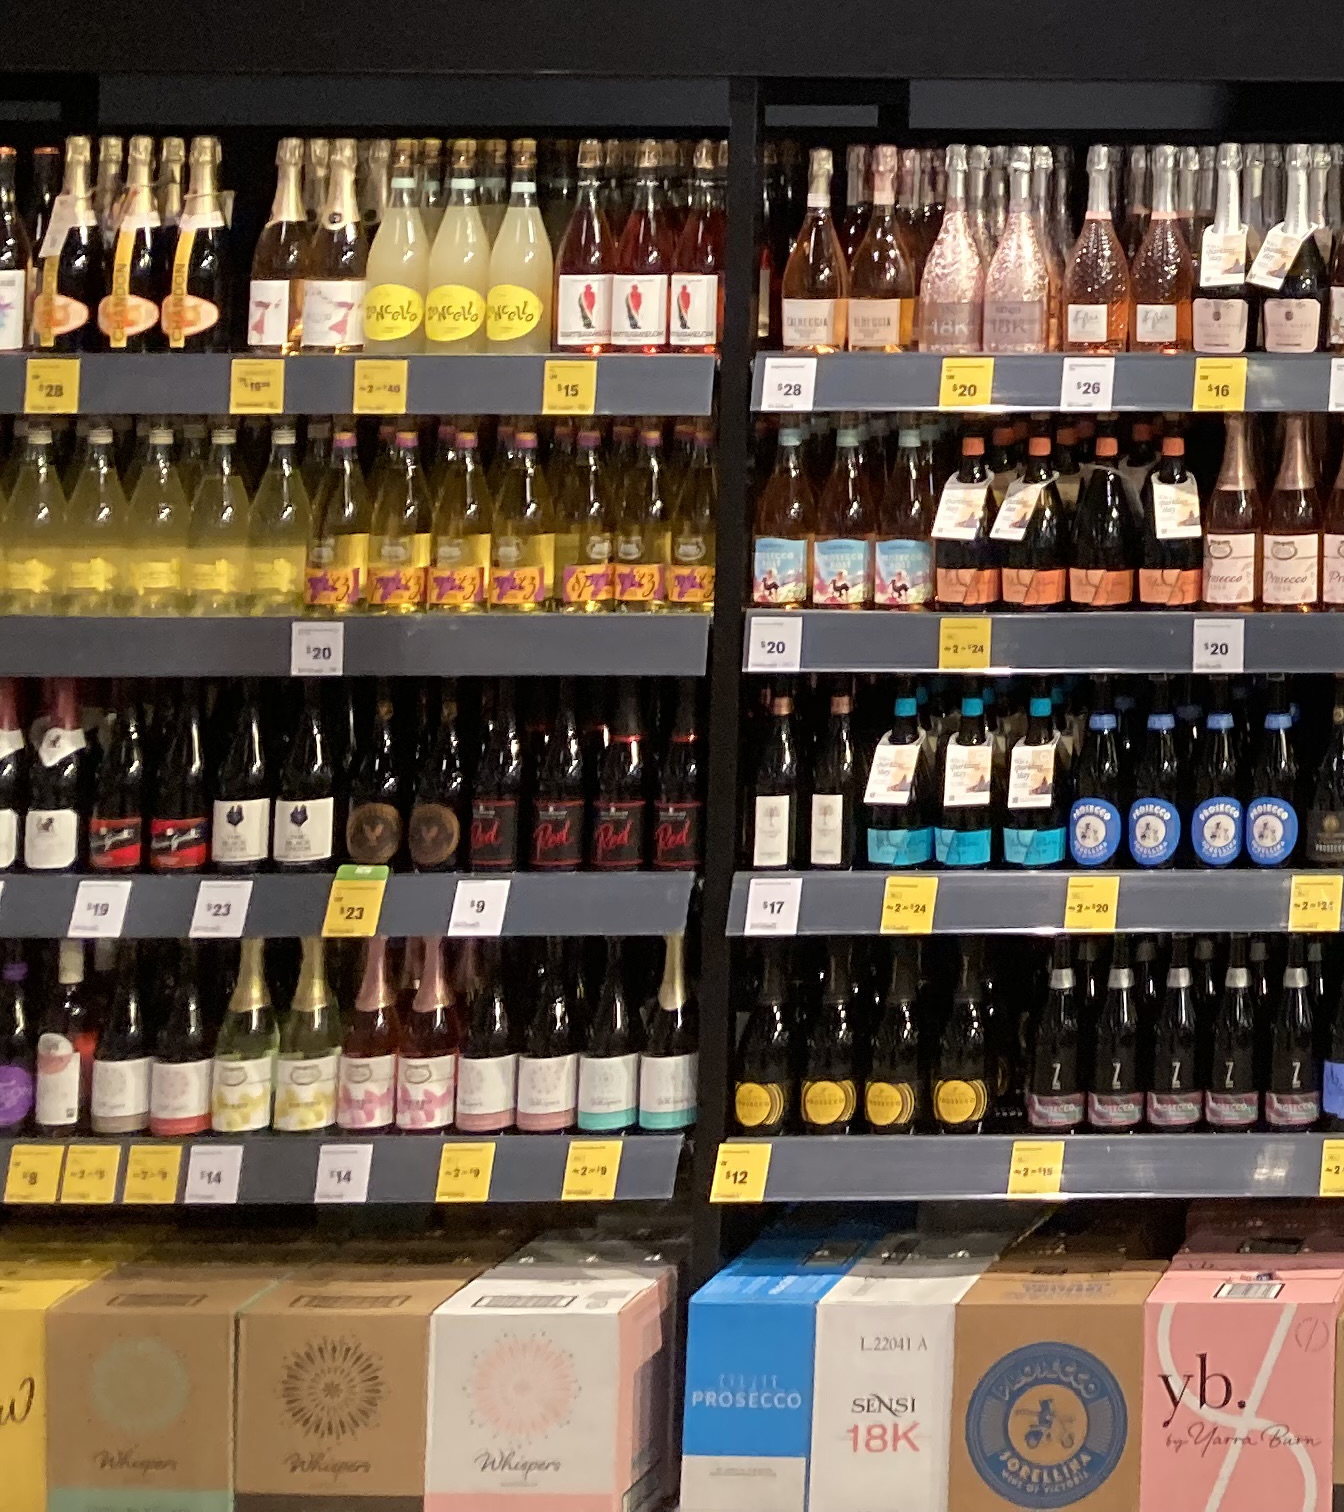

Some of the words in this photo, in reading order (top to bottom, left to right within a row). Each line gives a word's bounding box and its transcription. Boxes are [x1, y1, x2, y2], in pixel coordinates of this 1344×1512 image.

[557, 383, 579, 397] $15
[777, 382, 802, 397] $28
[951, 382, 977, 397] $20
[1076, 381, 1101, 395] $26
[1208, 383, 1230, 397] $16
[306, 645, 332, 660] $20
[760, 640, 786, 654] $20
[1204, 642, 1229, 656] $20
[339, 906, 365, 920] $23
[762, 901, 785, 915] $17
[725, 1170, 748, 1185] $12
[1157, 1352, 1248, 1428] yb.
[691, 1390, 802, 1410] PROSECCO
[850, 1393, 917, 1418] SENSI
[846, 1422, 921, 1454] 18K
[1262, 1423, 1323, 1450] Burn
[93, 1449, 179, 1474] Whispers
[285, 1450, 372, 1475] Whispers
[474, 1449, 562, 1474] Whispers
